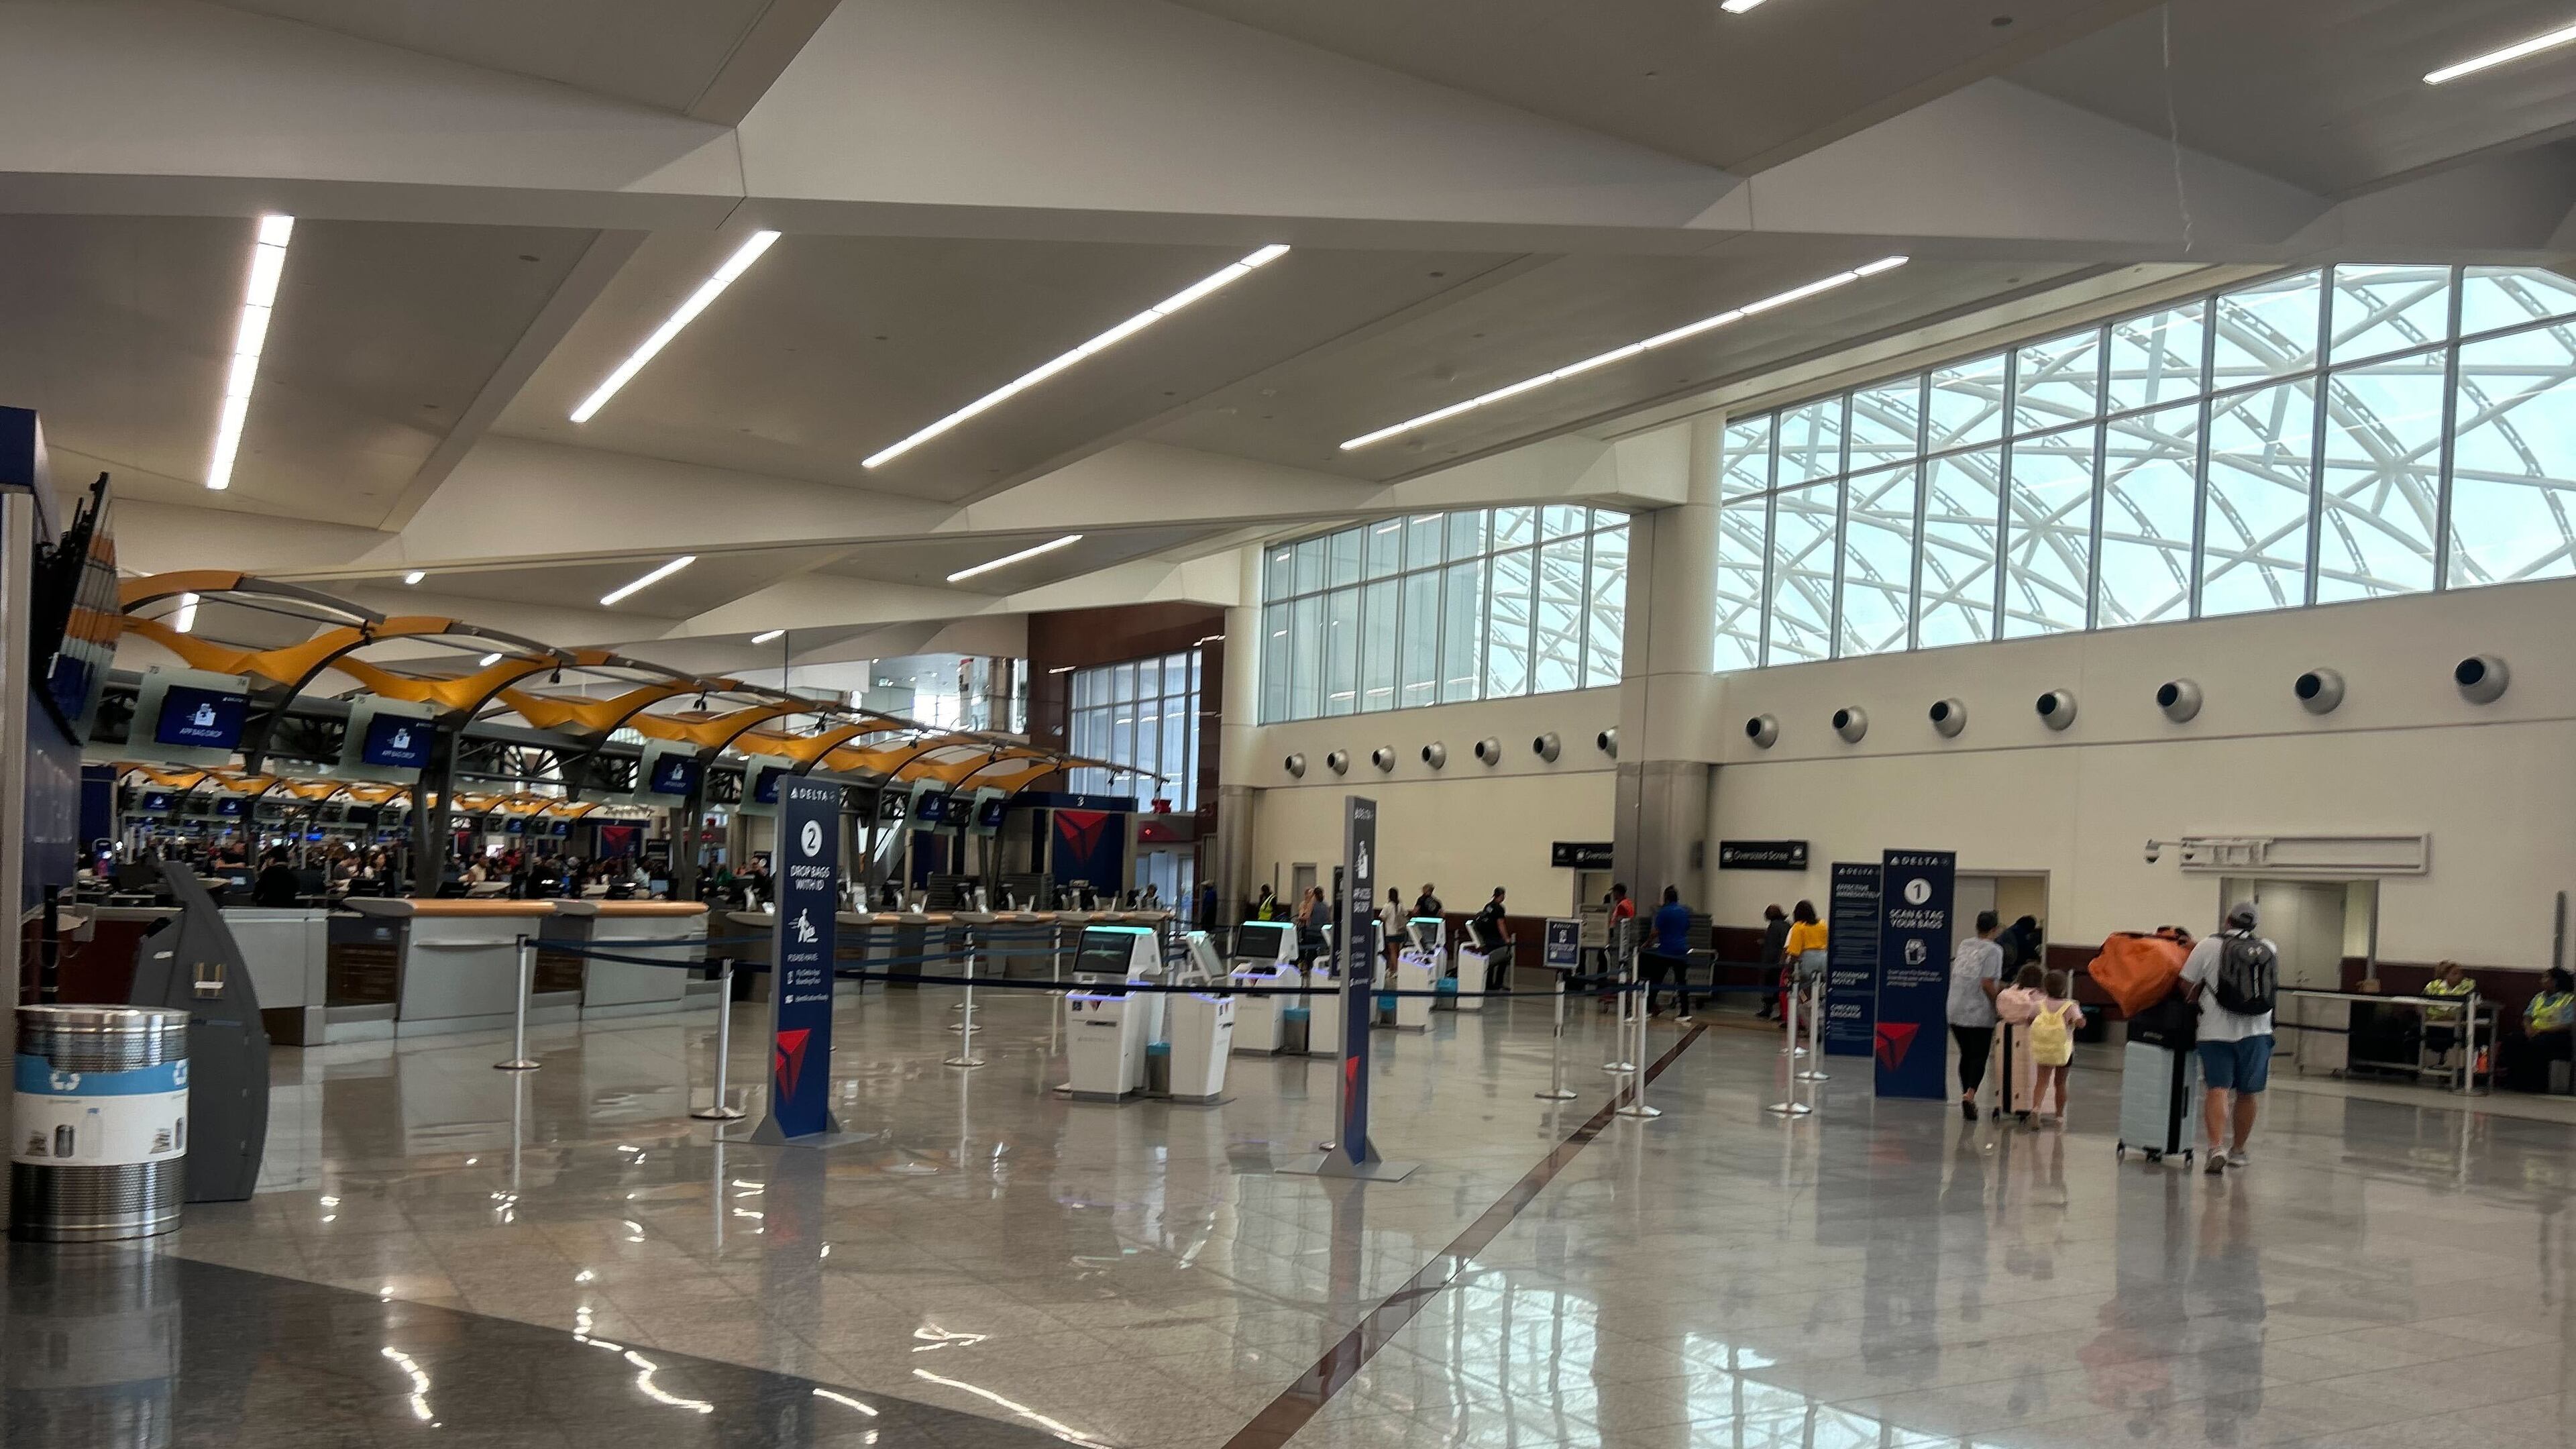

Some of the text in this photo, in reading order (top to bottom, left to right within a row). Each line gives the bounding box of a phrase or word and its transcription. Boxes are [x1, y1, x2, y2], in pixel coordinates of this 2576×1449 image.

[799, 788, 828, 802] DELTA
[807, 828, 816, 849] 2
[1900, 856, 1939, 866] DELTA
[790, 865, 811, 877] DROP
[1846, 867, 1874, 875] DELTA
[1913, 883, 1922, 900] 1
[1889, 908, 1915, 919] SCAN
[1923, 910, 1945, 920] TAG
[1890, 918, 1917, 928] YOUR
[1917, 919, 1943, 929] BAGS
